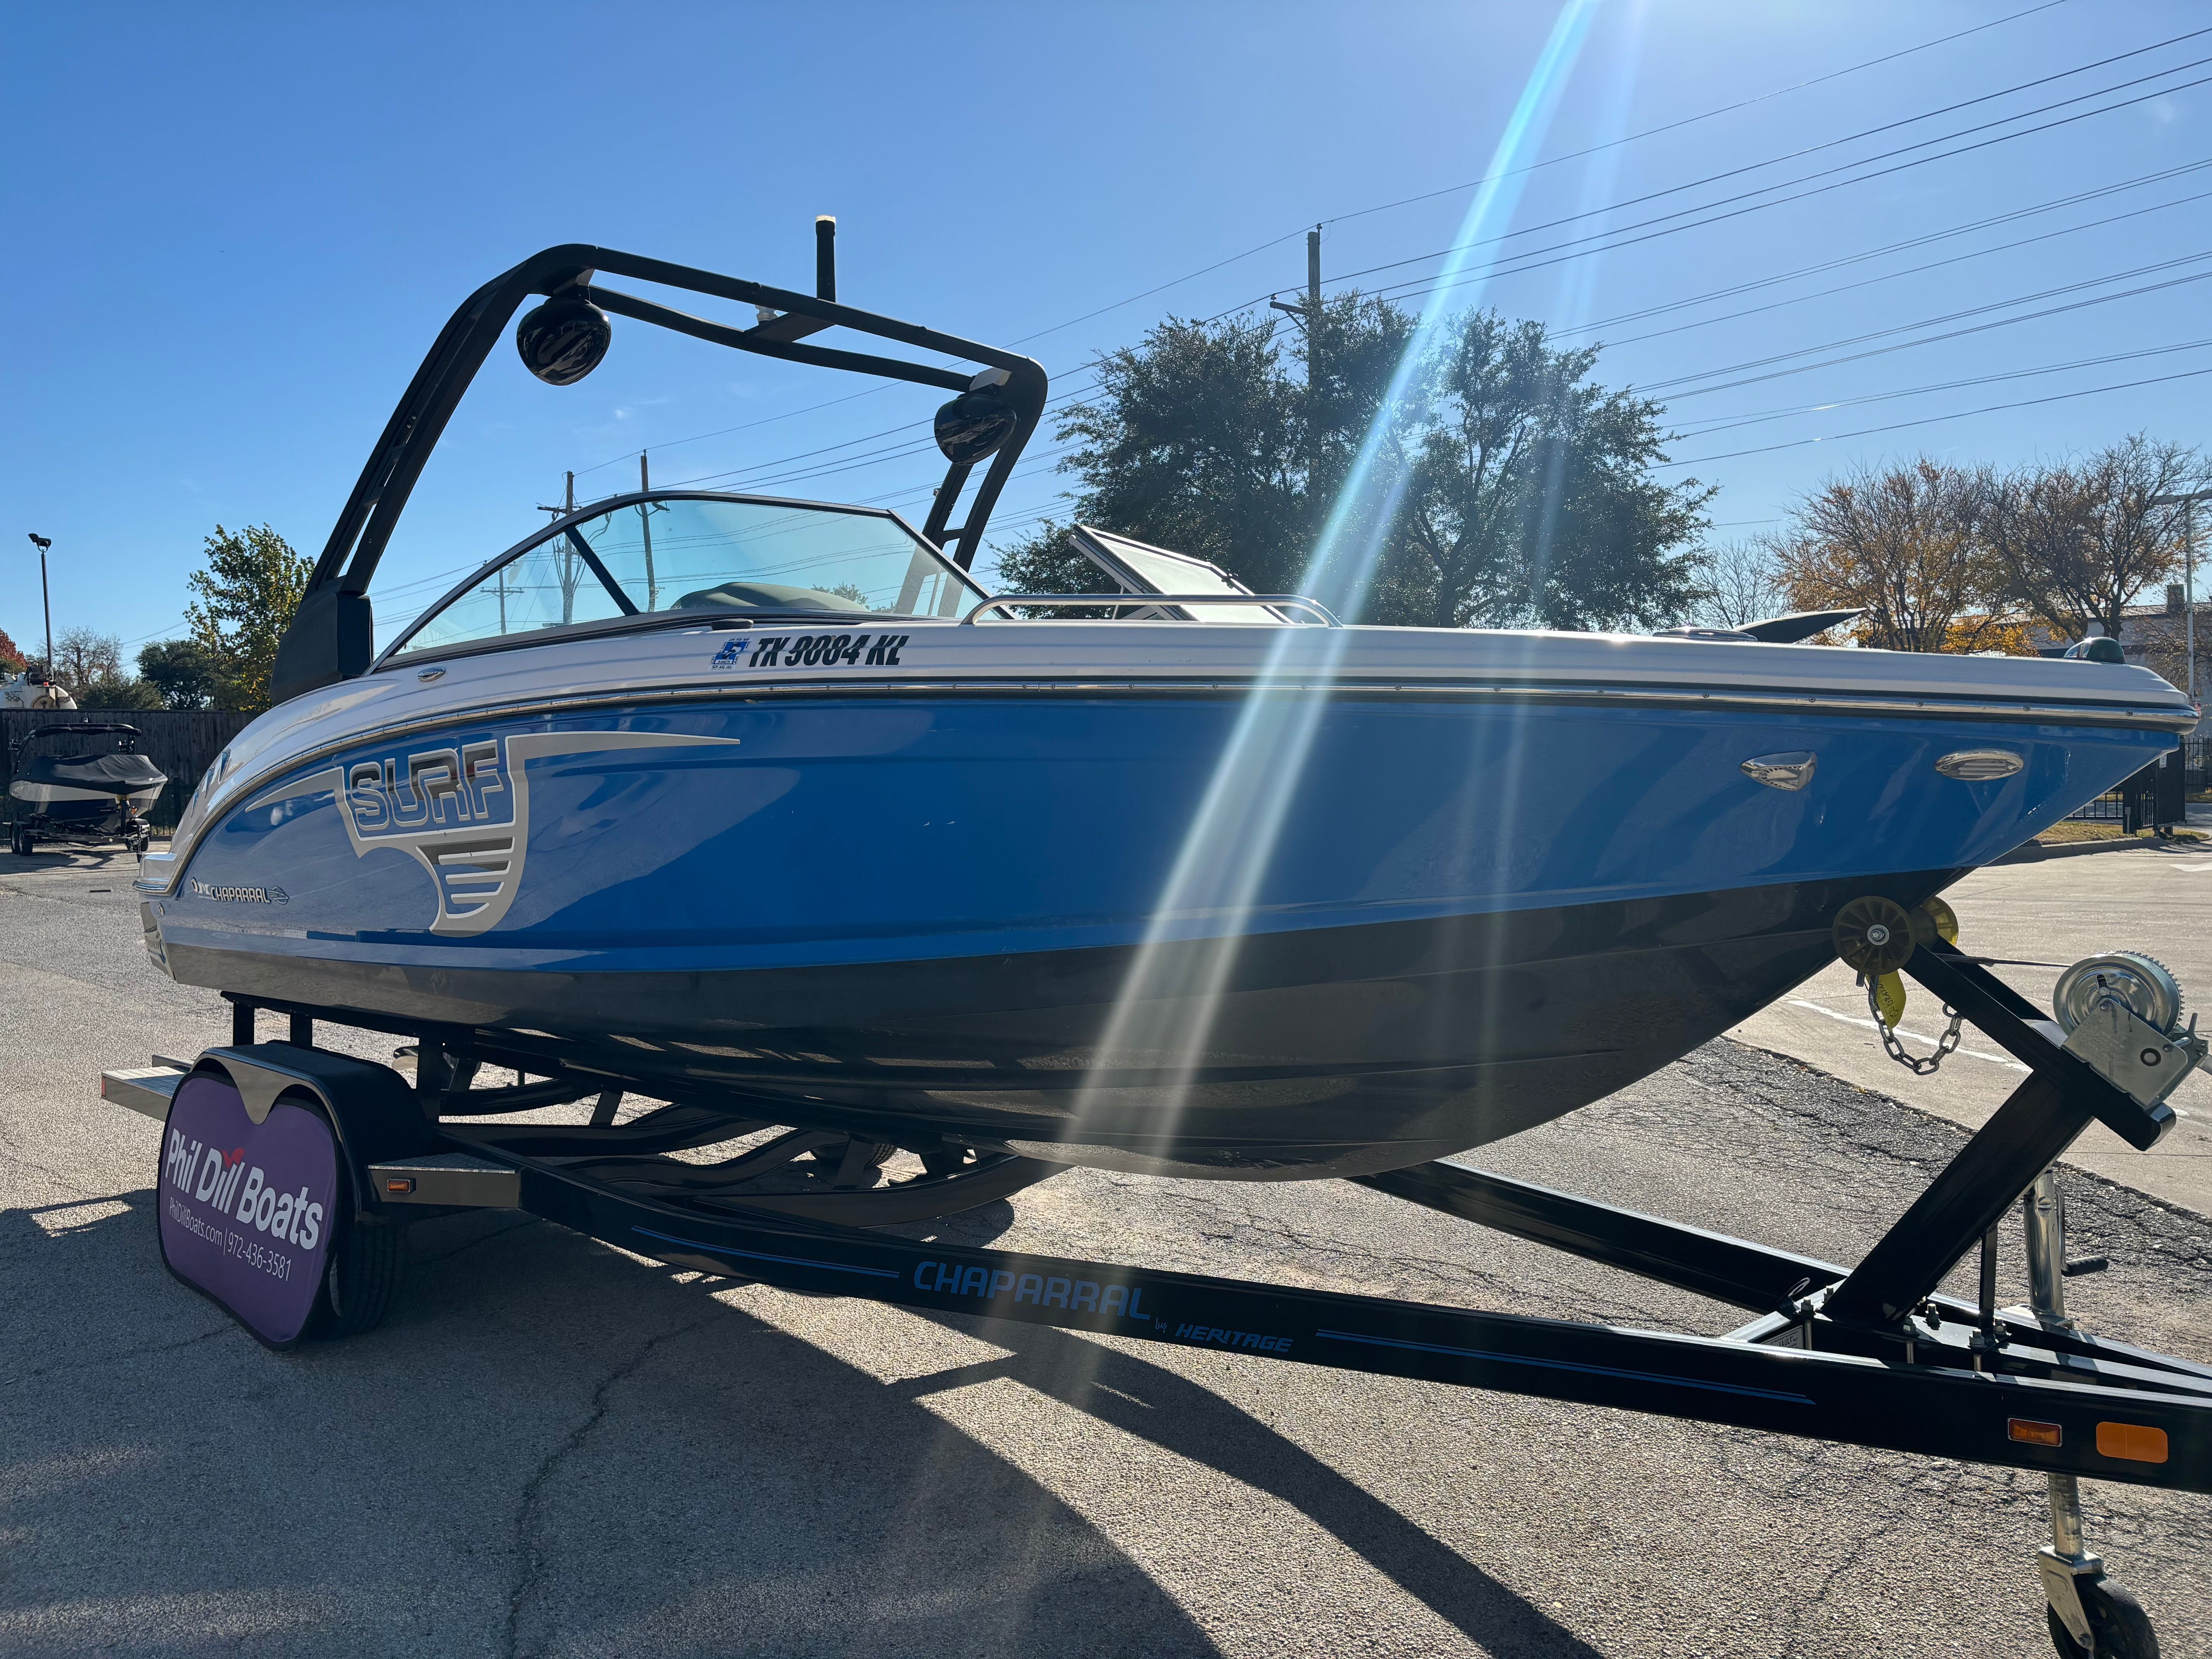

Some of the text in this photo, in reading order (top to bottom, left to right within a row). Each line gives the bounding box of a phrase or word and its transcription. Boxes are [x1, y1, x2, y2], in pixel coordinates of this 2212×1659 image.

[749, 634, 910, 667] TX 9084 KL
[349, 739, 504, 831] SURF
[211, 886, 270, 903] CHAPARRAL
[165, 1128, 323, 1250] Phil Dill Boats
[169, 1197, 222, 1247] PhilDillBoats.com
[228, 1232, 291, 1281] 972-436-3581
[914, 1261, 1150, 1320] CHAPARRAL
[1175, 1323, 1293, 1352] HERITAGE
[1778, 1336, 1793, 1346] VAULT
